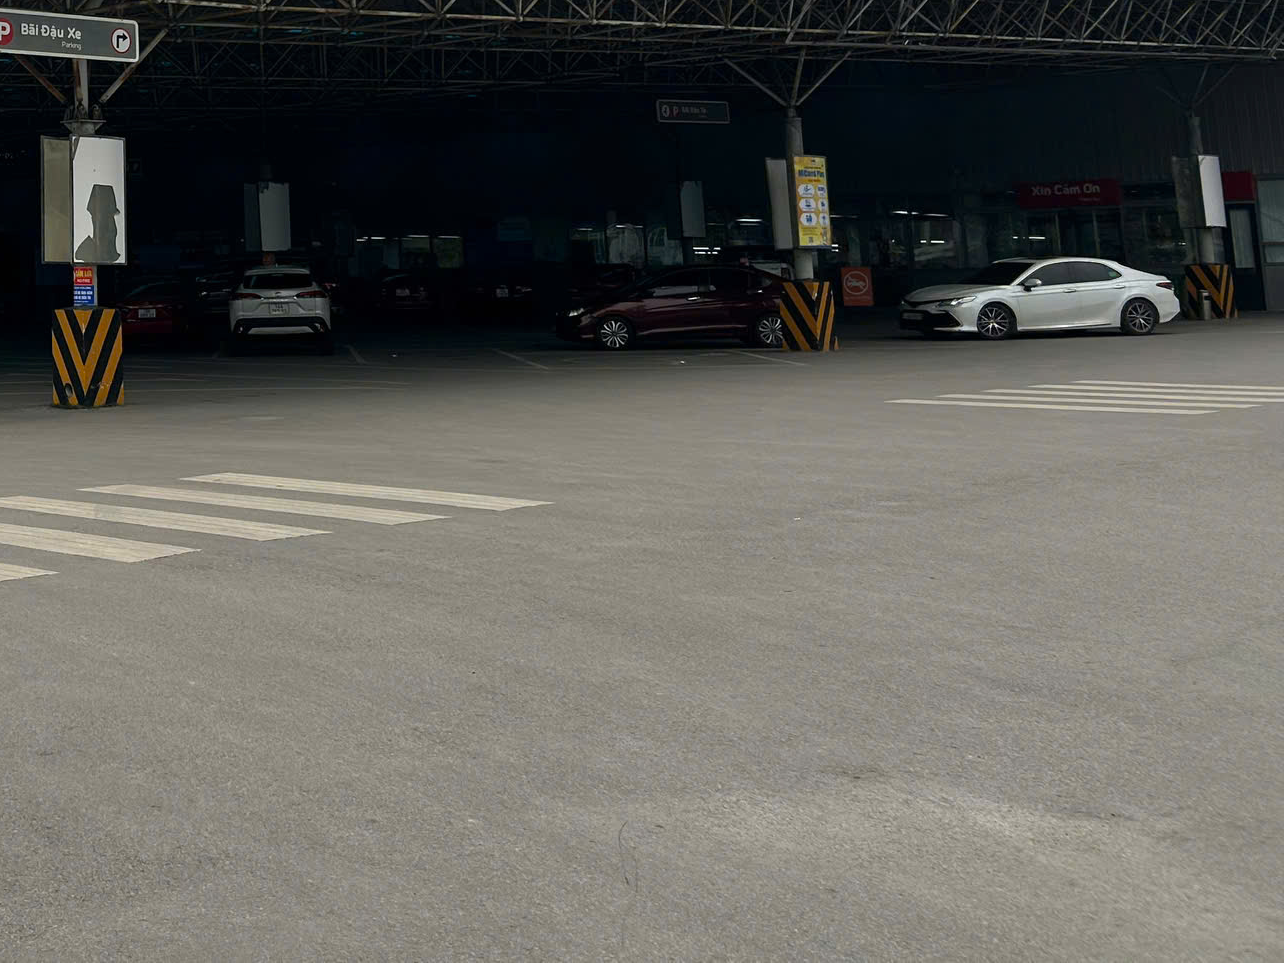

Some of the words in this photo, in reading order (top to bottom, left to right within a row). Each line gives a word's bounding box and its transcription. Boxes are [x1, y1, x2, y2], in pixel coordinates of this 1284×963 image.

[21, 23, 39, 36] Bãi
[41, 24, 64, 40] Đậu
[67, 27, 82, 40] Xe
[61, 41, 82, 51] Parking
